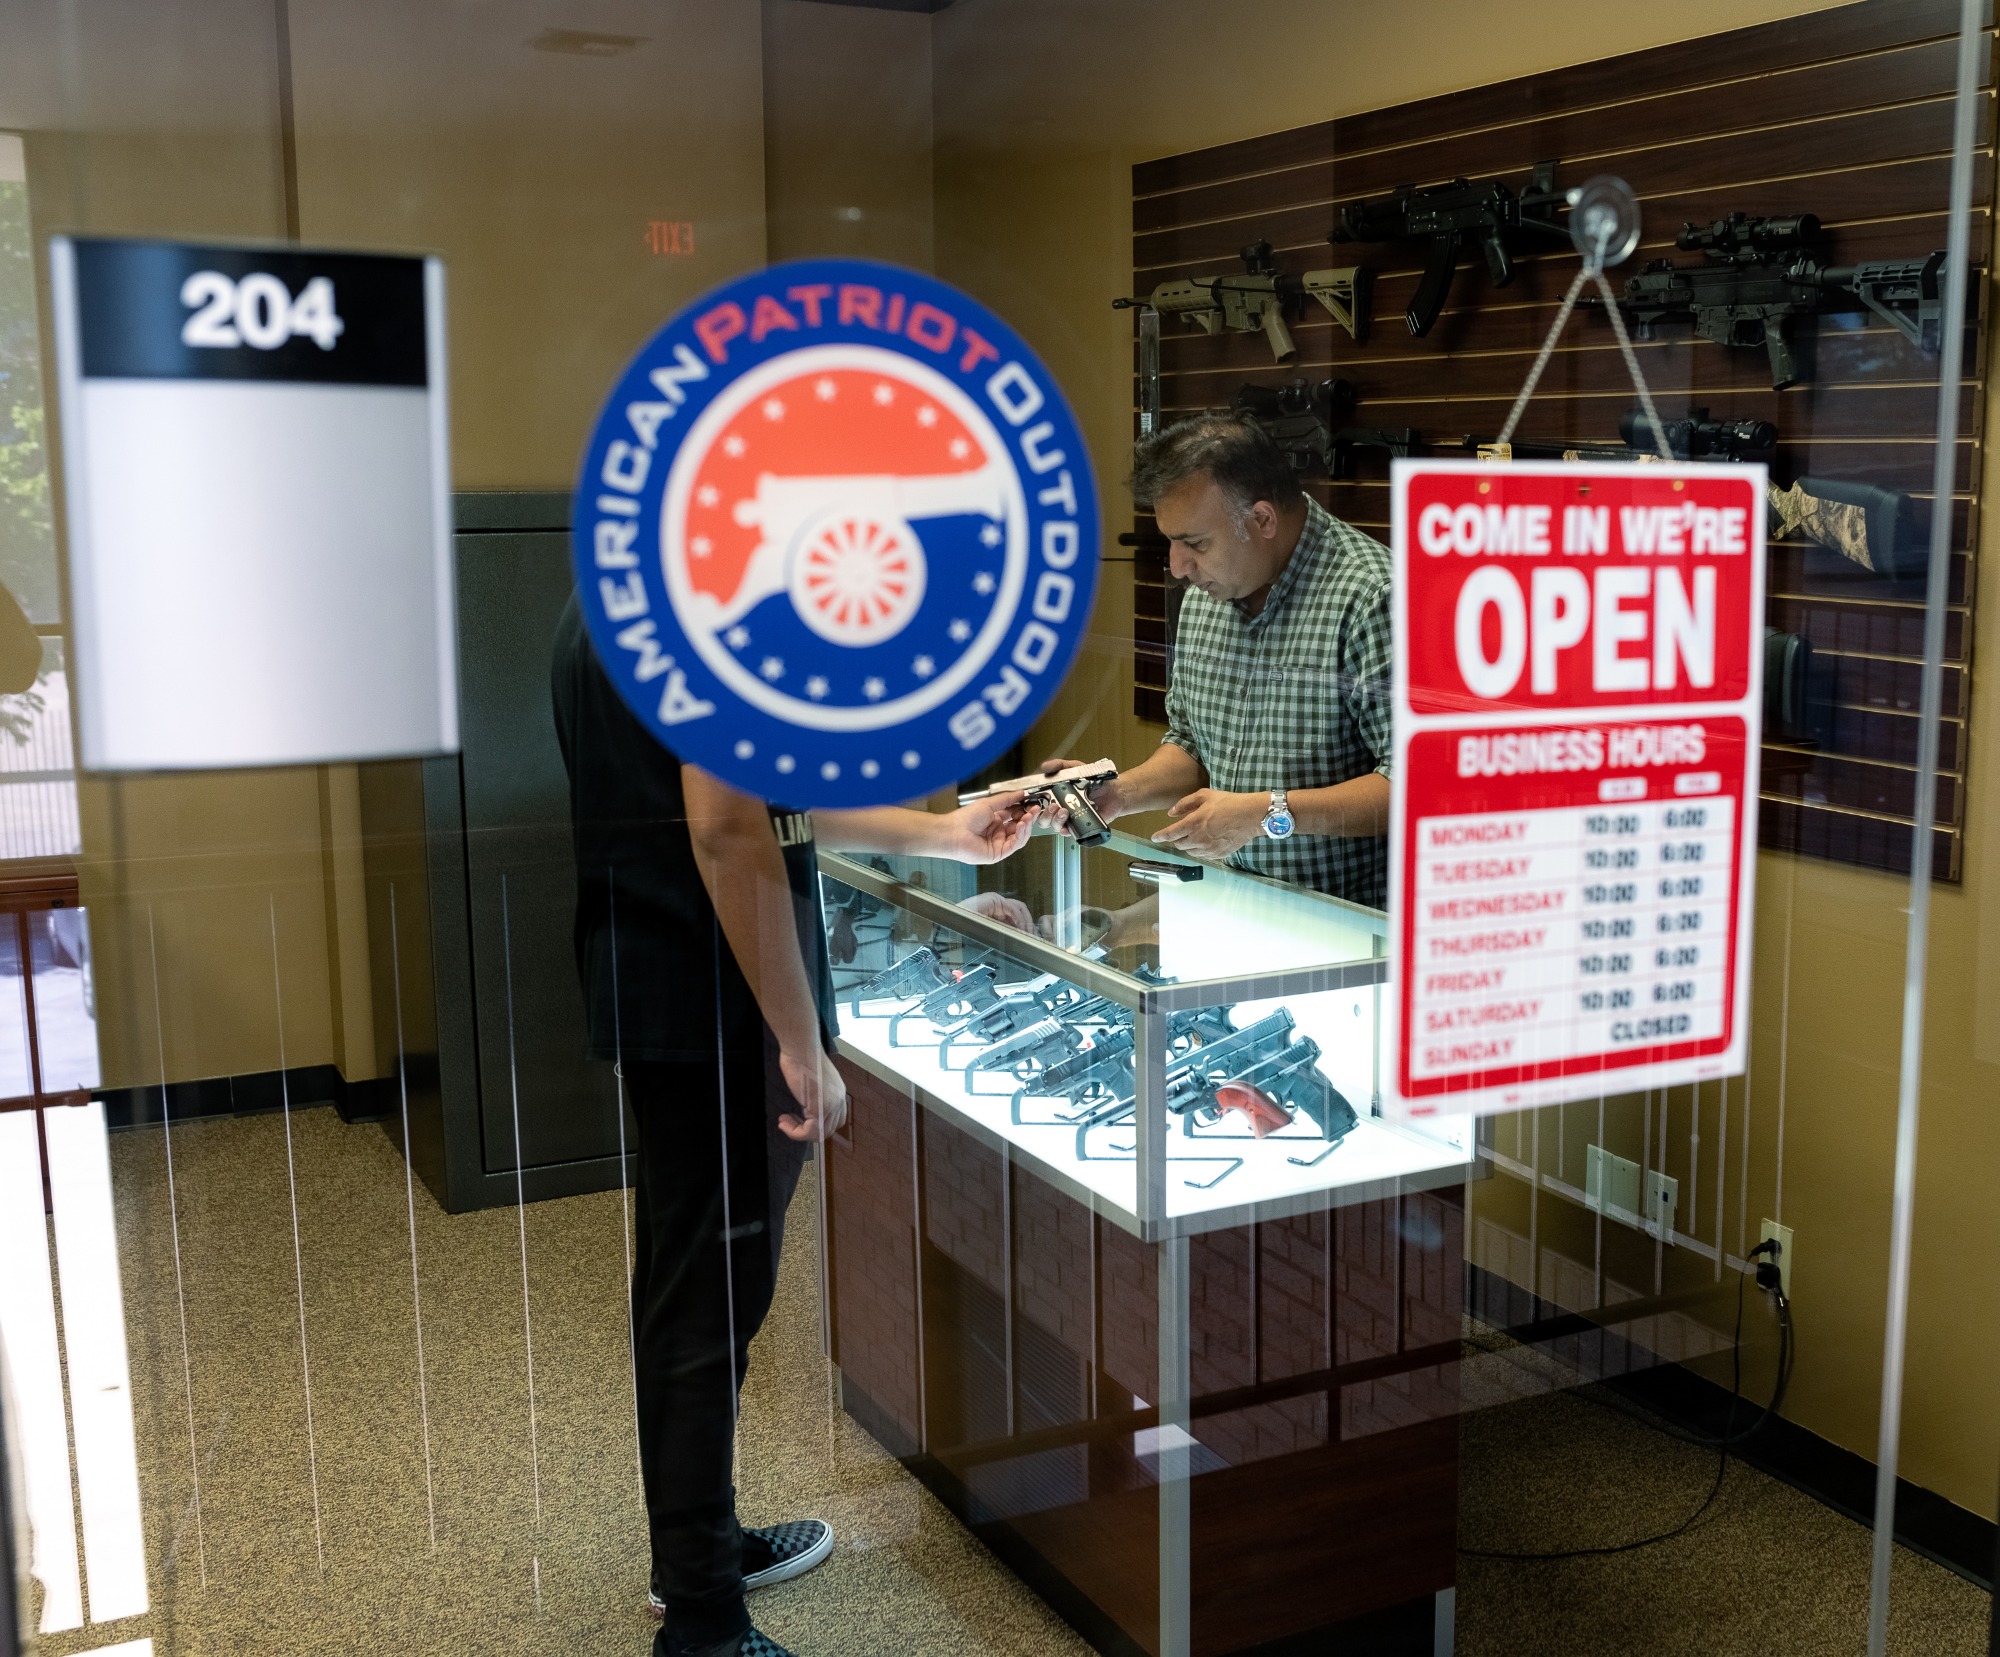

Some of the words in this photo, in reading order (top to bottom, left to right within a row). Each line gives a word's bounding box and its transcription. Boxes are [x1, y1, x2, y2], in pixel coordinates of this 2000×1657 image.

[180, 269, 346, 351] 204
[594, 343, 717, 727] AMERICAN
[693, 284, 1000, 373] PATRIOT
[947, 360, 1080, 751] OUTDOORS
[1417, 502, 1553, 558] COME
[1562, 505, 1610, 556] IN
[1619, 501, 1747, 555] WE'RE
[1454, 564, 1718, 698] OPEN
[1457, 729, 1603, 778] BUSINESS
[1608, 724, 1706, 768] HOURS
[1428, 820, 1529, 848] MONDAY
[1430, 857, 1533, 885] TUESDAY
[1428, 890, 1567, 920] WEDNESDAY
[1428, 927, 1548, 957] THURSDAY
[1425, 968, 1506, 994] FRIDAY
[1425, 999, 1543, 1032] SATURDAY
[1424, 1038, 1516, 1066] SUNDAY
[1610, 1014, 1692, 1044] CLOSED
